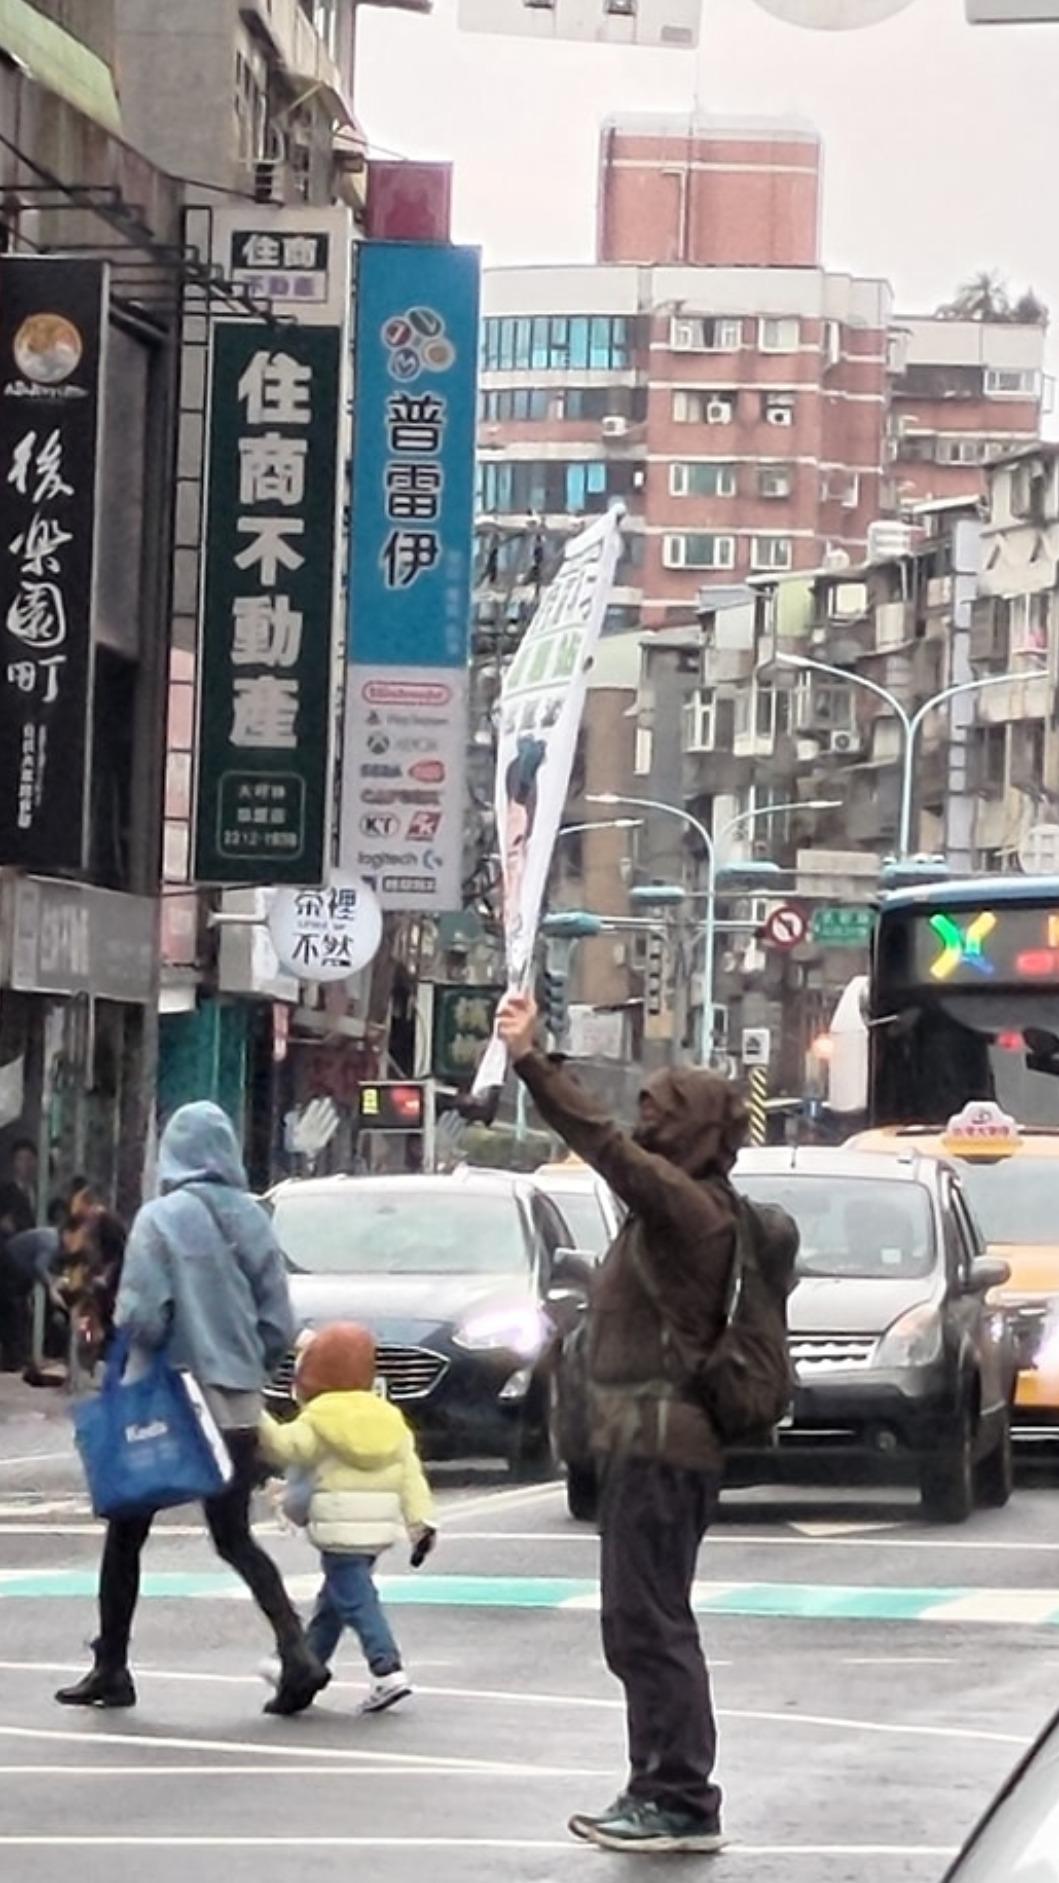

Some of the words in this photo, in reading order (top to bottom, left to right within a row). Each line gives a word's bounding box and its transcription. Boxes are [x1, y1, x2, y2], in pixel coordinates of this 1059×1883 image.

[242, 233, 317, 268] 住商
[7, 429, 75, 703] 後樂園町
[228, 350, 312, 749] 住商不動產
[382, 392, 445, 589] 普雷伊
